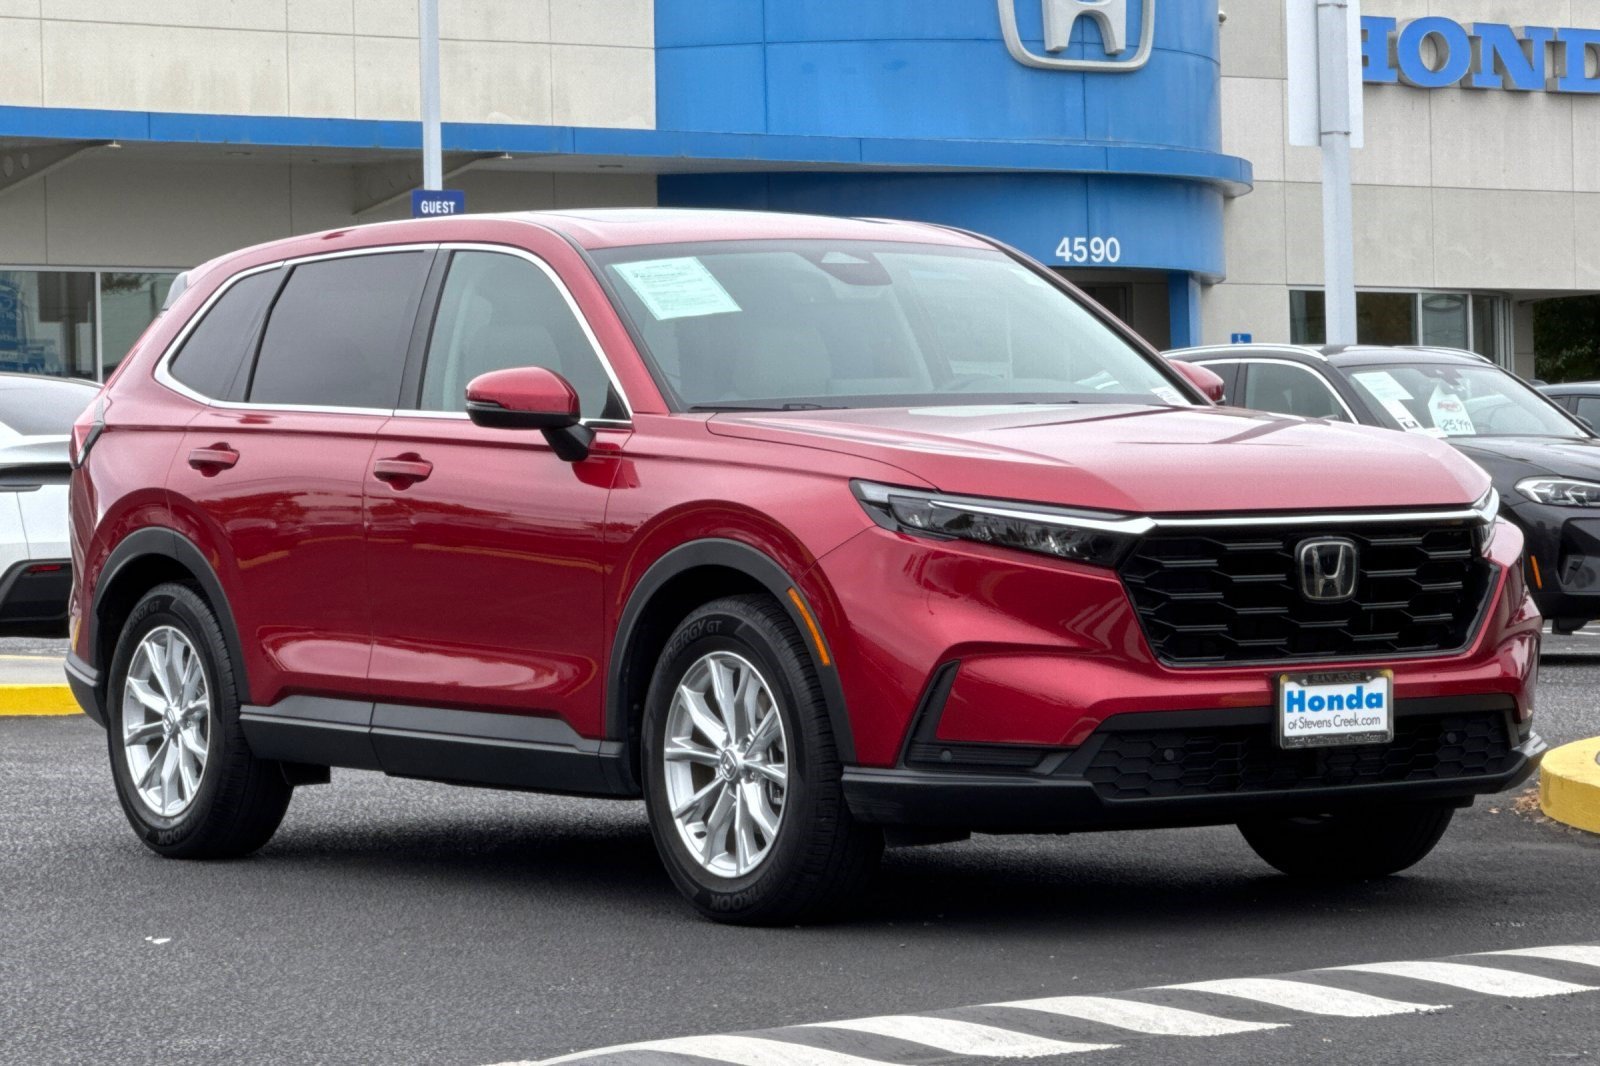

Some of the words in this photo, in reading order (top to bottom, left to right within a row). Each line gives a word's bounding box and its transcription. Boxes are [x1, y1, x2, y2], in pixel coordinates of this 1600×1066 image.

[421, 200, 455, 214] GUEST
[1055, 236, 1121, 263] 4590
[1286, 685, 1384, 713] Honda
[1288, 717, 1298, 730] of
[1298, 715, 1332, 729] Stevens
[1333, 712, 1381, 727] Creek.com
